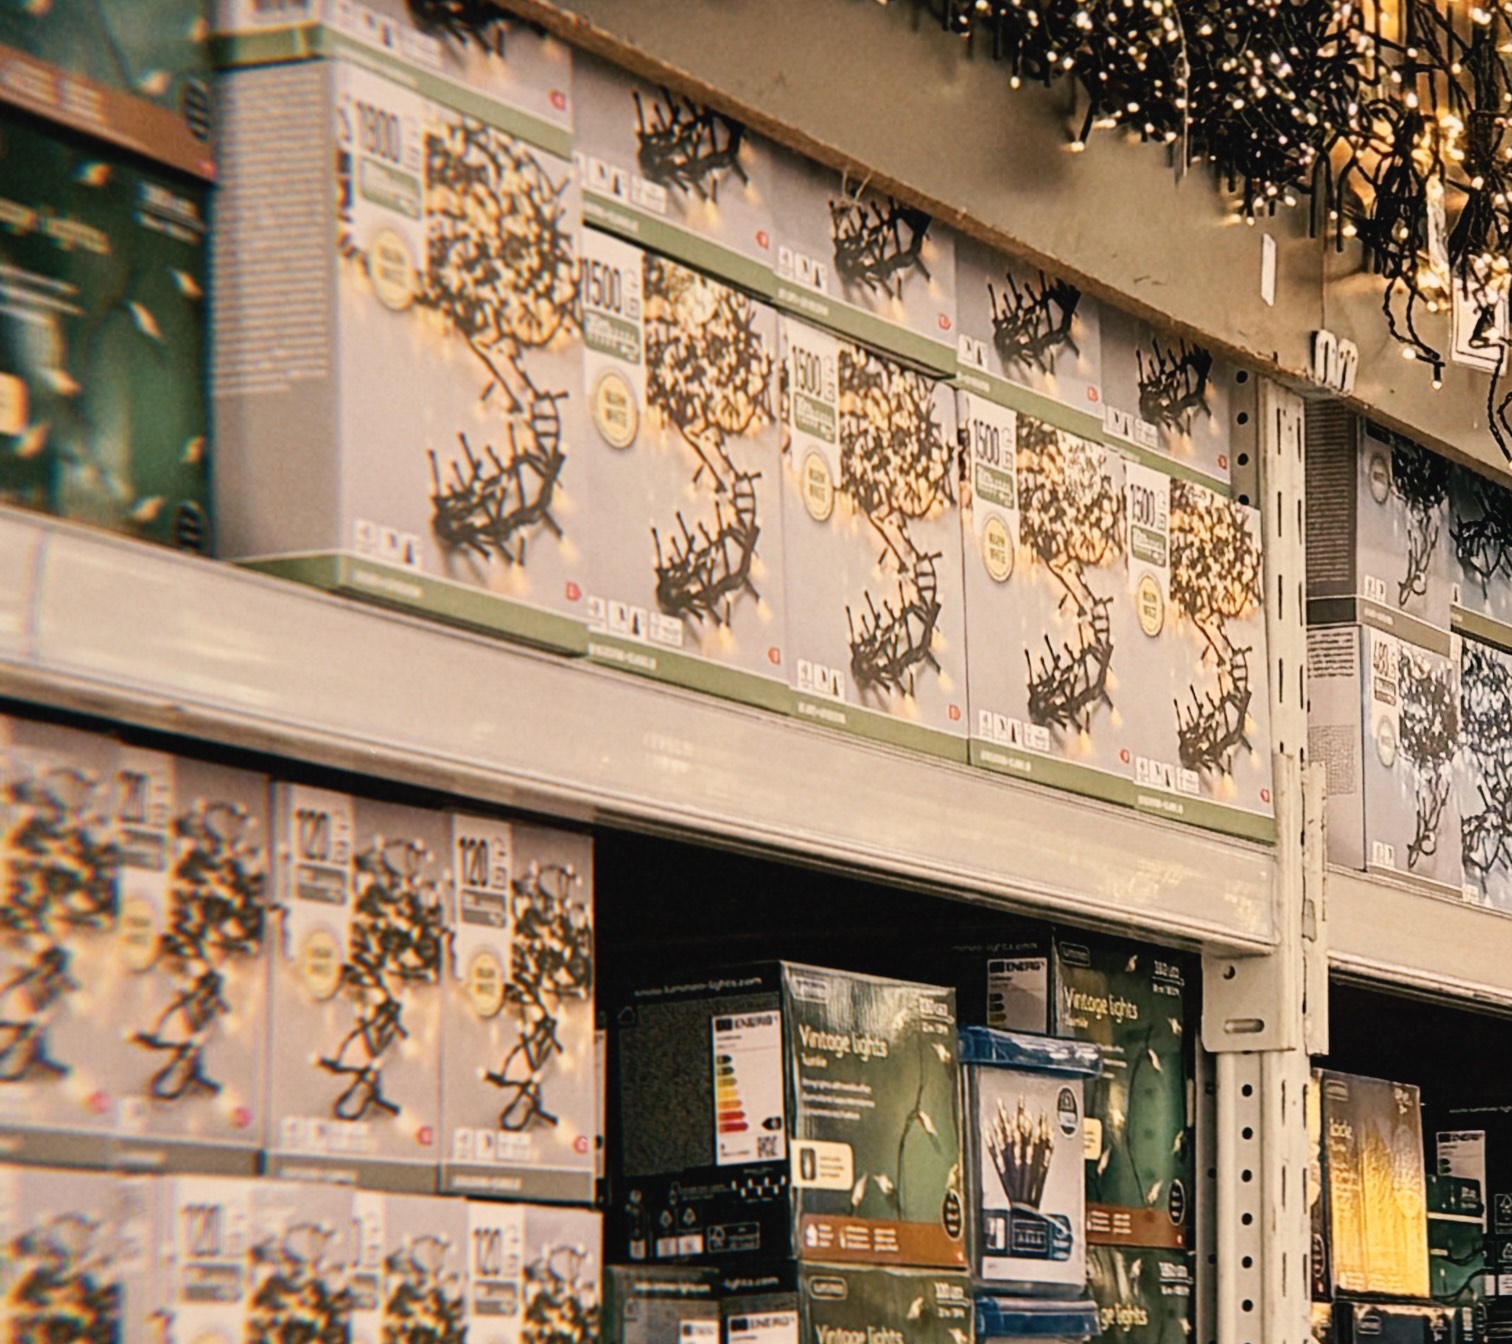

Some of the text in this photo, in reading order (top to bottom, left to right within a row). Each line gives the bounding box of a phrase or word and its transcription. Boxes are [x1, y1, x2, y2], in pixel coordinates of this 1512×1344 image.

[1063, 985, 1138, 1024] Vintage lights
[798, 1022, 888, 1063] Vintage lights
